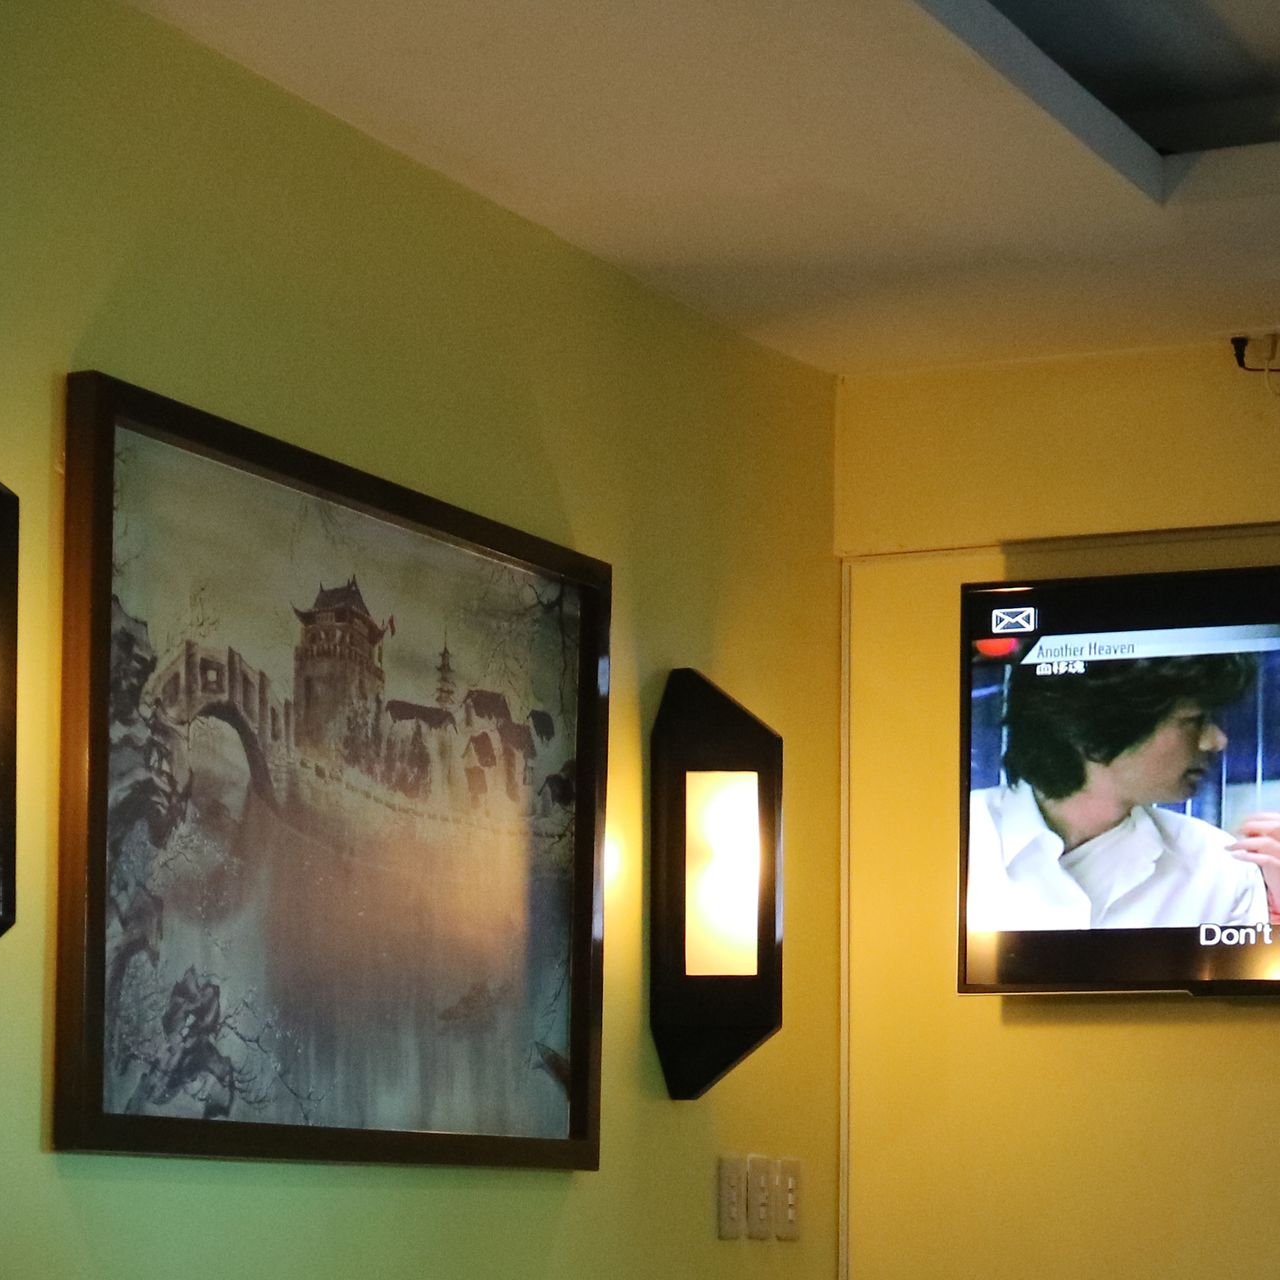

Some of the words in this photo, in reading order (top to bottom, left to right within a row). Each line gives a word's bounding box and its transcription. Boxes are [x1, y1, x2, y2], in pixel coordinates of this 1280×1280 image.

[1036, 643, 1084, 659] Another
[1088, 642, 1135, 657] Heaven
[1199, 923, 1273, 946] Don't
